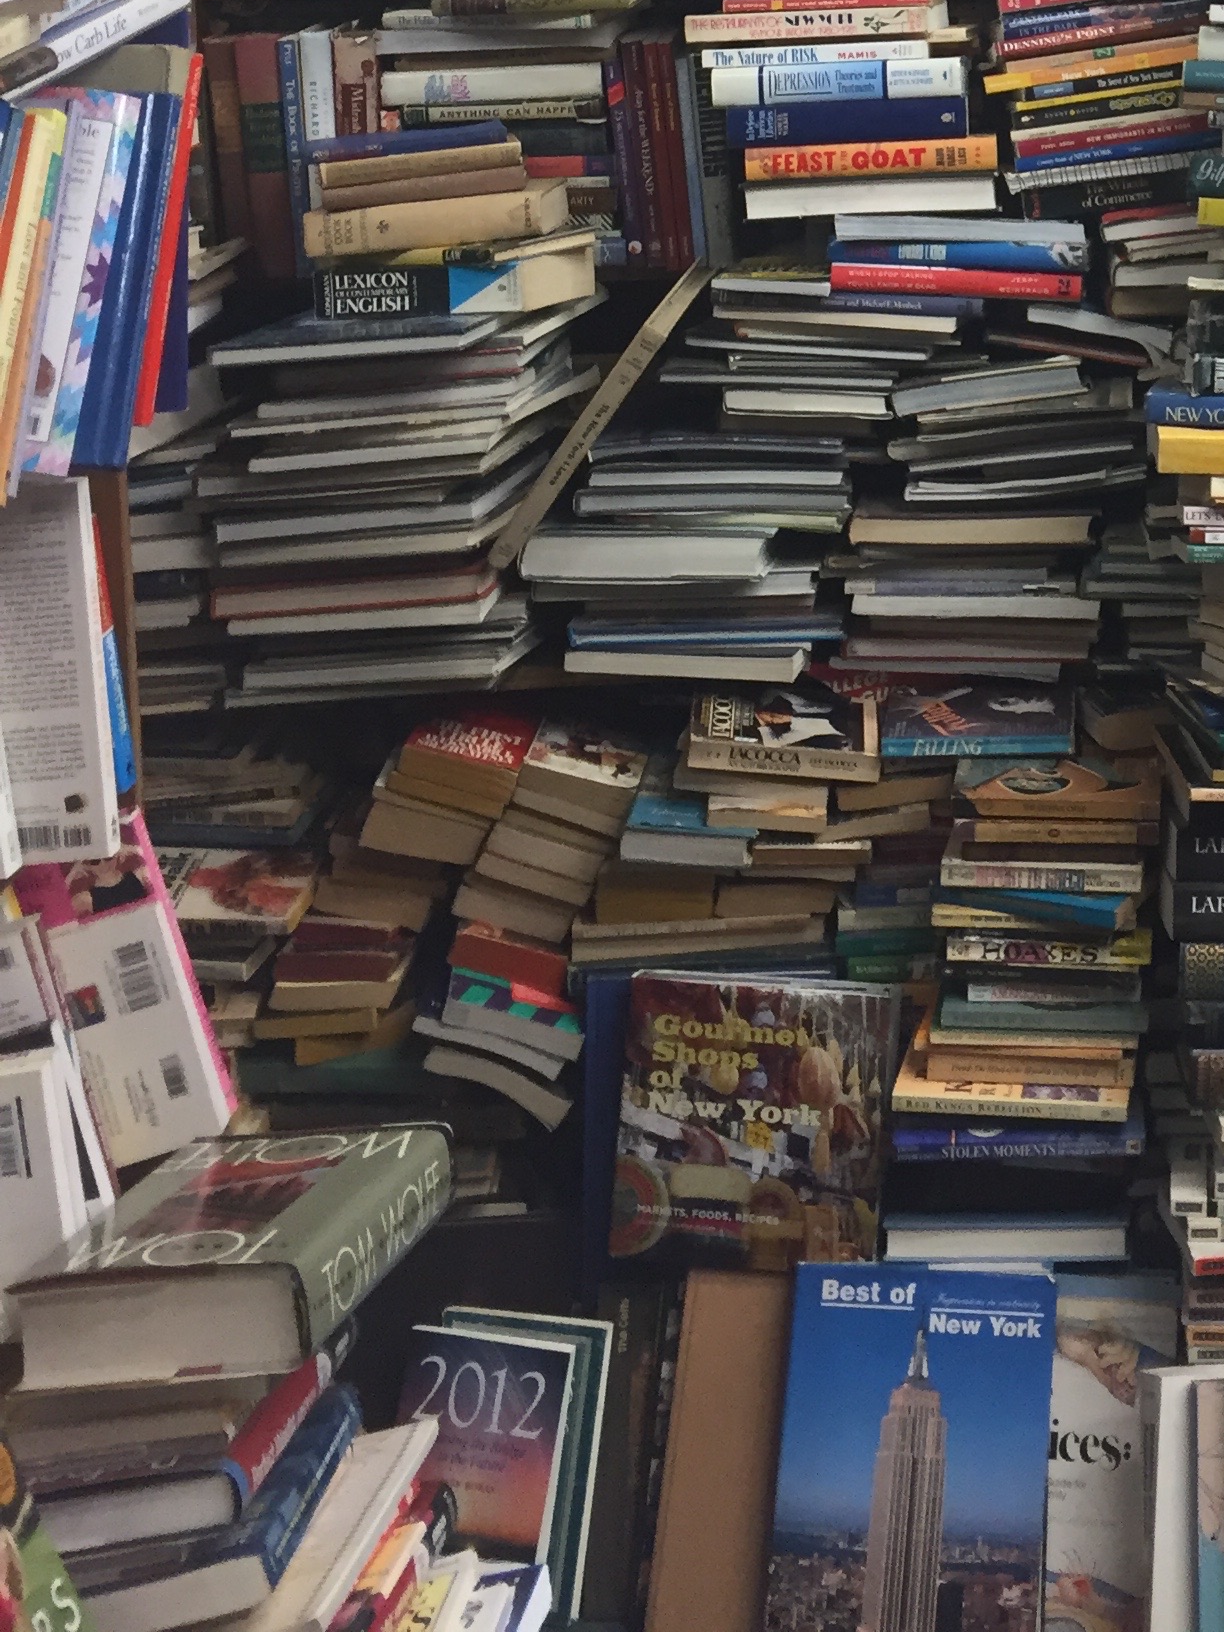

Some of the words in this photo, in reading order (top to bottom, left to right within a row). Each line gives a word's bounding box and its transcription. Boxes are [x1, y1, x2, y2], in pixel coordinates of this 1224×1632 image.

[713, 51, 734, 66] The
[737, 50, 774, 65] Nature
[775, 48, 789, 63] of
[791, 46, 819, 62] RISK
[837, 51, 878, 60] MAMIS
[771, 152, 837, 174] FEAST
[851, 148, 927, 169] GOAT
[334, 272, 409, 291] LEXICON
[334, 294, 410, 314] ENGLISH
[1165, 406, 1199, 421] NEW
[981, 940, 1098, 966] HOAXES
[653, 1013, 810, 1048] Gourmet
[652, 1041, 759, 1070] Shops
[650, 1069, 683, 1089] of
[648, 1091, 727, 1120] New
[736, 1098, 822, 1127] York
[321, 1230, 378, 1322] TOM
[382, 1160, 441, 1258] WOLFE
[821, 1280, 879, 1306] Best
[884, 1279, 916, 1305] of
[928, 1312, 979, 1338] New
[986, 1314, 1044, 1340] York
[411, 1355, 547, 1440] 2012
